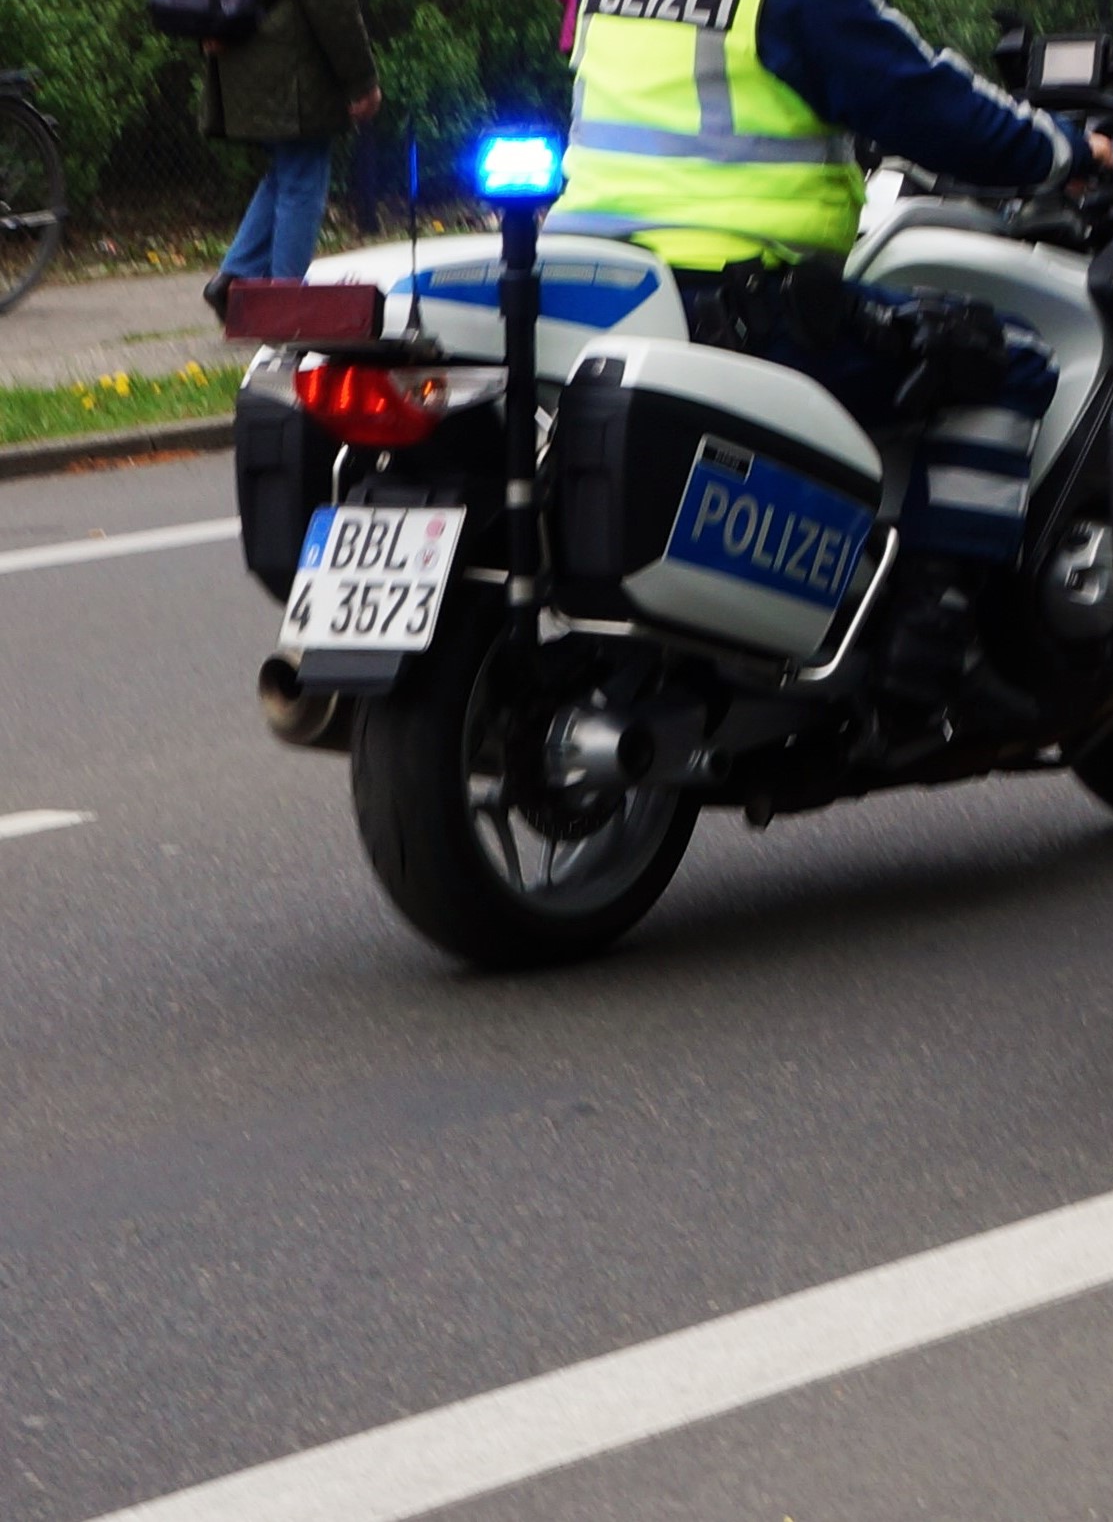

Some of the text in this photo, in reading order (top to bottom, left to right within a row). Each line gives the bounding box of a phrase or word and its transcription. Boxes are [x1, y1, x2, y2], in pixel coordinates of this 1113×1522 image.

[330, 518, 409, 570] BBL
[691, 480, 852, 595] POLIZEI
[288, 579, 437, 635] 4 3573
